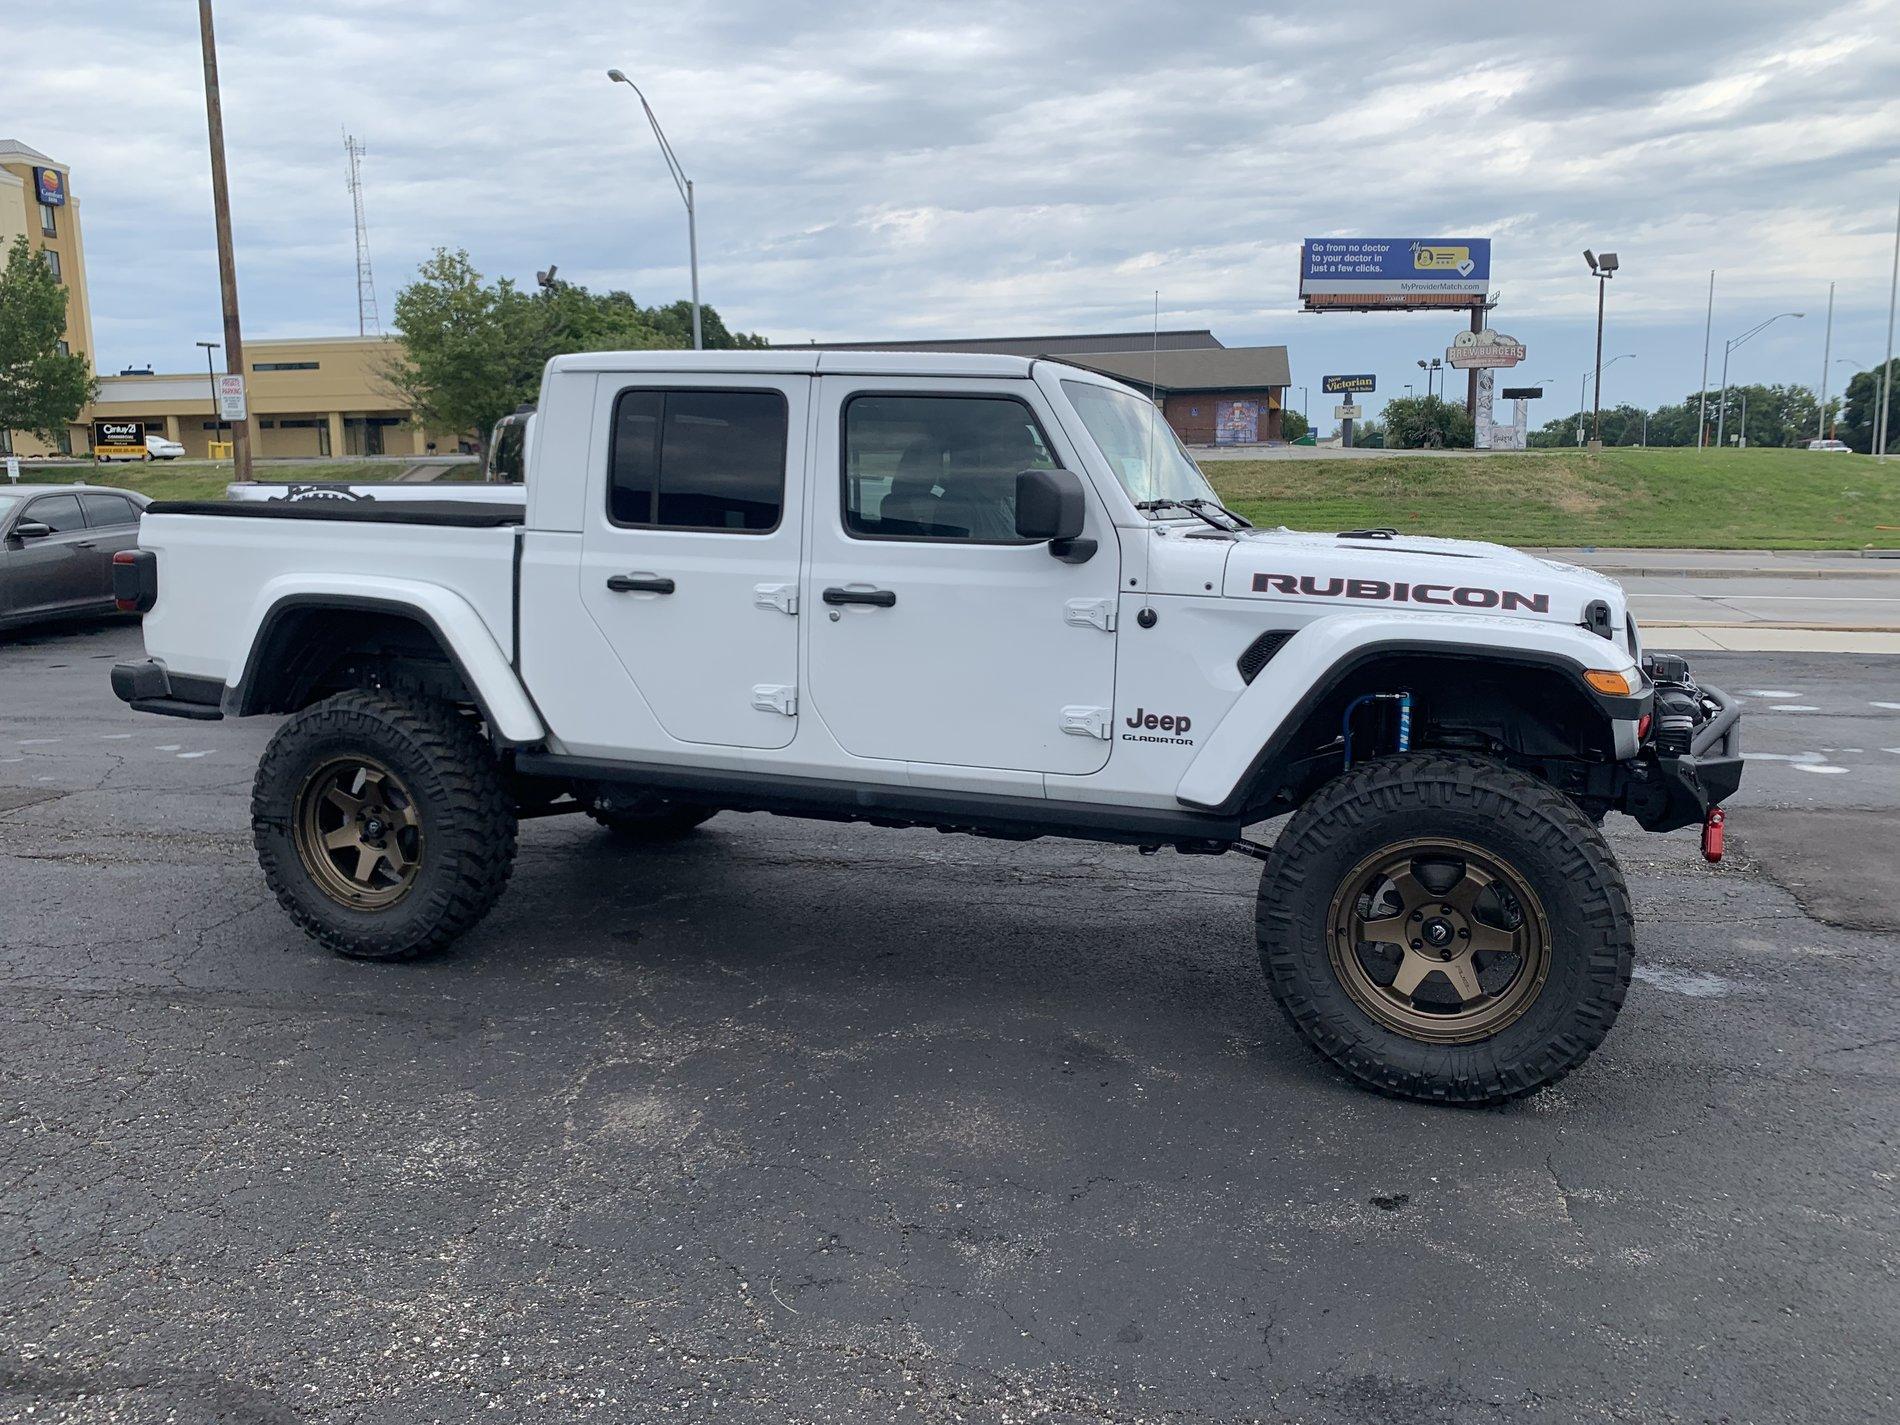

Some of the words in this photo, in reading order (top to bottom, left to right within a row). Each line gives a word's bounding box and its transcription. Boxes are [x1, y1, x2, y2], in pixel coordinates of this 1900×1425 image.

[1312, 243, 1324, 252] Go
[1326, 243, 1346, 252] from
[1362, 243, 1390, 252] doctor
[1311, 254, 1321, 262] to
[1323, 255, 1342, 264] your
[1344, 254, 1372, 262] doctor
[1374, 254, 1382, 262] in
[1310, 264, 1328, 274] just
[1338, 264, 1353, 272] few
[1355, 264, 1383, 272] clicks.
[1400, 283, 1480, 292] MyProviderMatch.com
[1326, 378, 1373, 391] Victorian
[1251, 573, 1549, 614] RUBICON
[1126, 707, 1191, 736] Jeep
[1122, 734, 1194, 746] GLADIATOR
